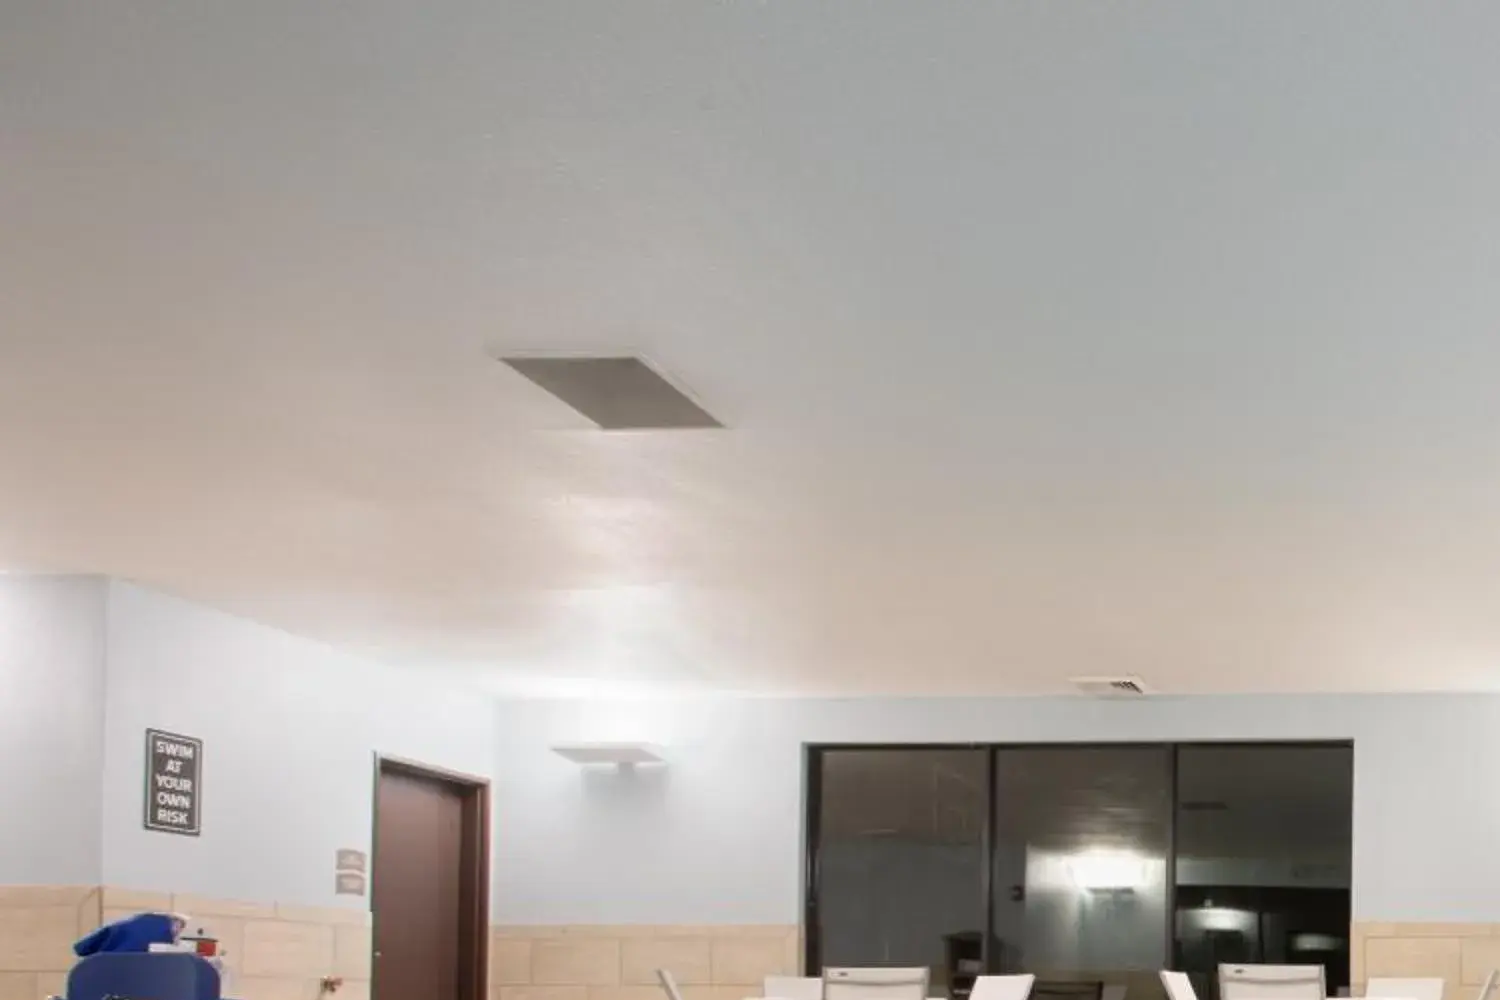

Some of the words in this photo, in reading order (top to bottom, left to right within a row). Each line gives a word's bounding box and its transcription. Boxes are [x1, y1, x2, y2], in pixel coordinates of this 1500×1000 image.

[156, 741, 193, 759] SWIM
[166, 759, 183, 773] AT
[156, 773, 192, 793] YOUR
[157, 791, 191, 809] OWN
[157, 809, 188, 825] RISK
